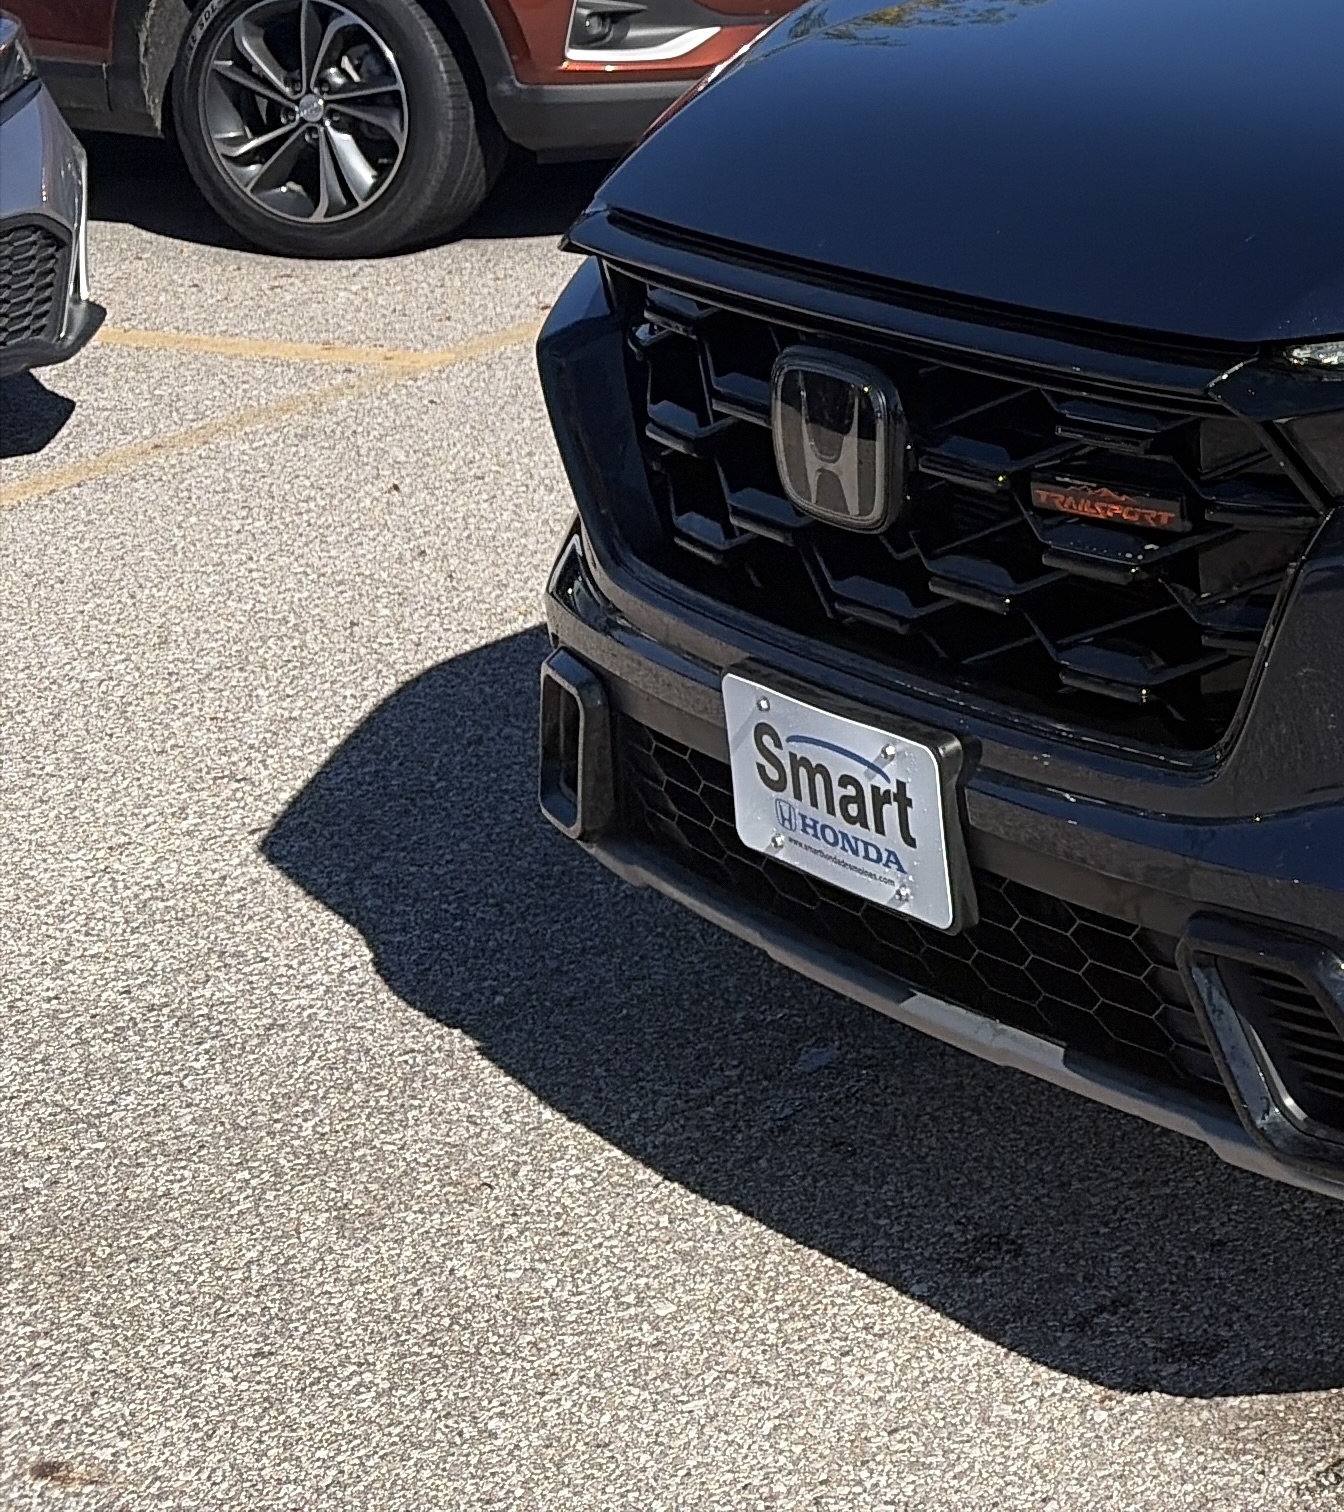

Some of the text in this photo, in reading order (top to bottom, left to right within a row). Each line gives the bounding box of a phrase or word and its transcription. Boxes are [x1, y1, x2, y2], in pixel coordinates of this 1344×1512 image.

[1034, 489, 1176, 527] TRAILSPORT
[753, 722, 918, 849] Smart
[798, 812, 908, 874] HONDA
